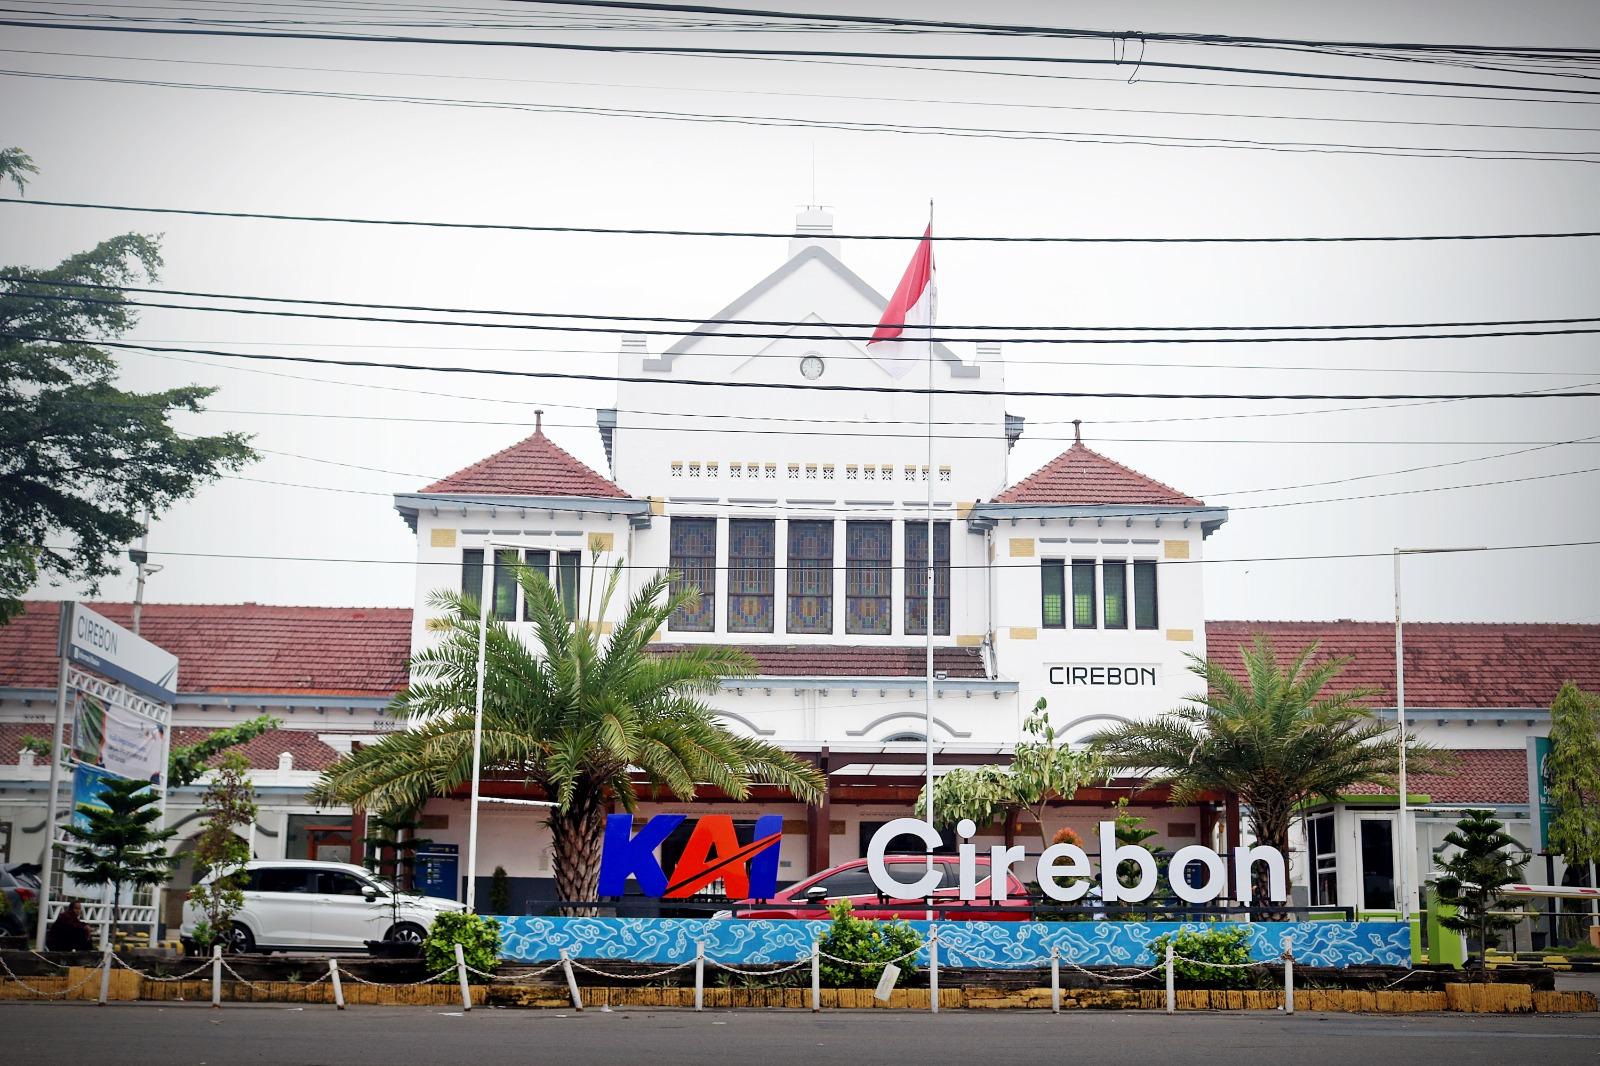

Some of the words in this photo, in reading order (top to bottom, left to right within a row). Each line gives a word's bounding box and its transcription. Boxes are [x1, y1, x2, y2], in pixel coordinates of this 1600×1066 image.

[77, 615, 118, 656] CIREBON
[1049, 666, 1156, 686] CIREBON
[598, 813, 783, 900] KAI
[867, 817, 1287, 904] Cirebon
